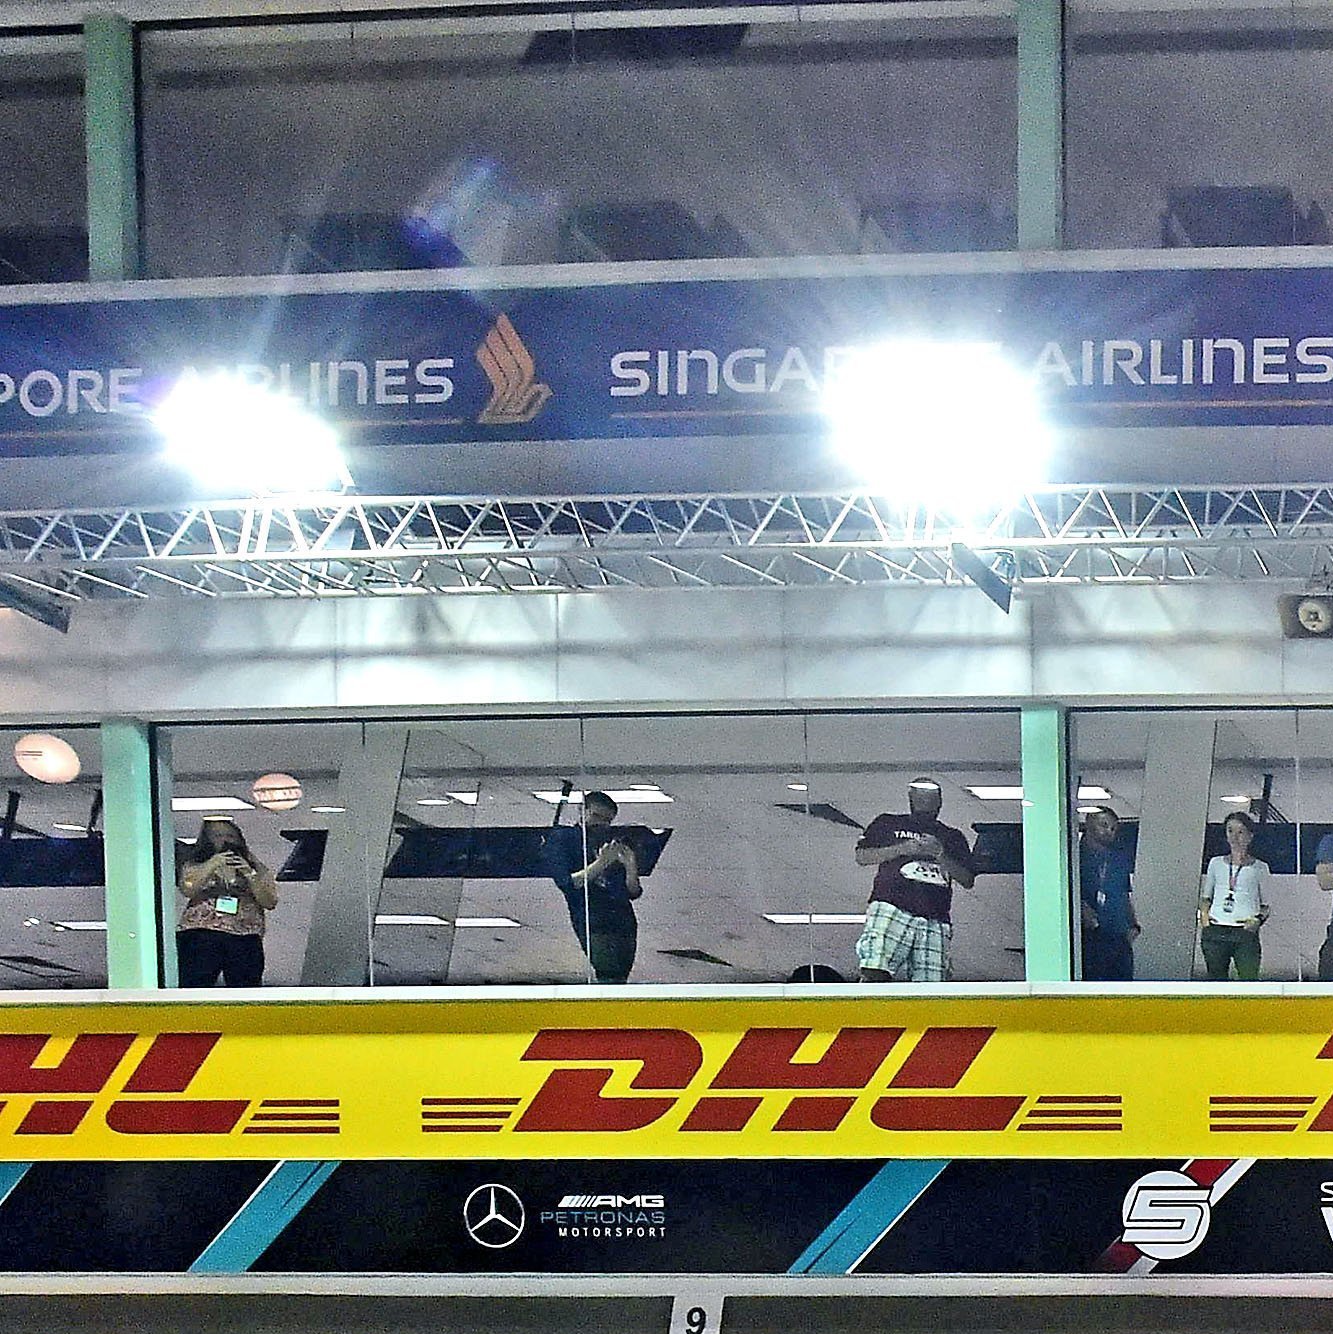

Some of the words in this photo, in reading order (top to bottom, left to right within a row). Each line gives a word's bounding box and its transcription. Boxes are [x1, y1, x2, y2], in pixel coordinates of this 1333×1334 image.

[513, 1027, 1024, 1132] DHL
[590, 1195, 665, 1208] AMG
[540, 1211, 665, 1224] PETRONAS
[1123, 1184, 1212, 1245] 5
[558, 1227, 666, 1237] MOTORSPORT
